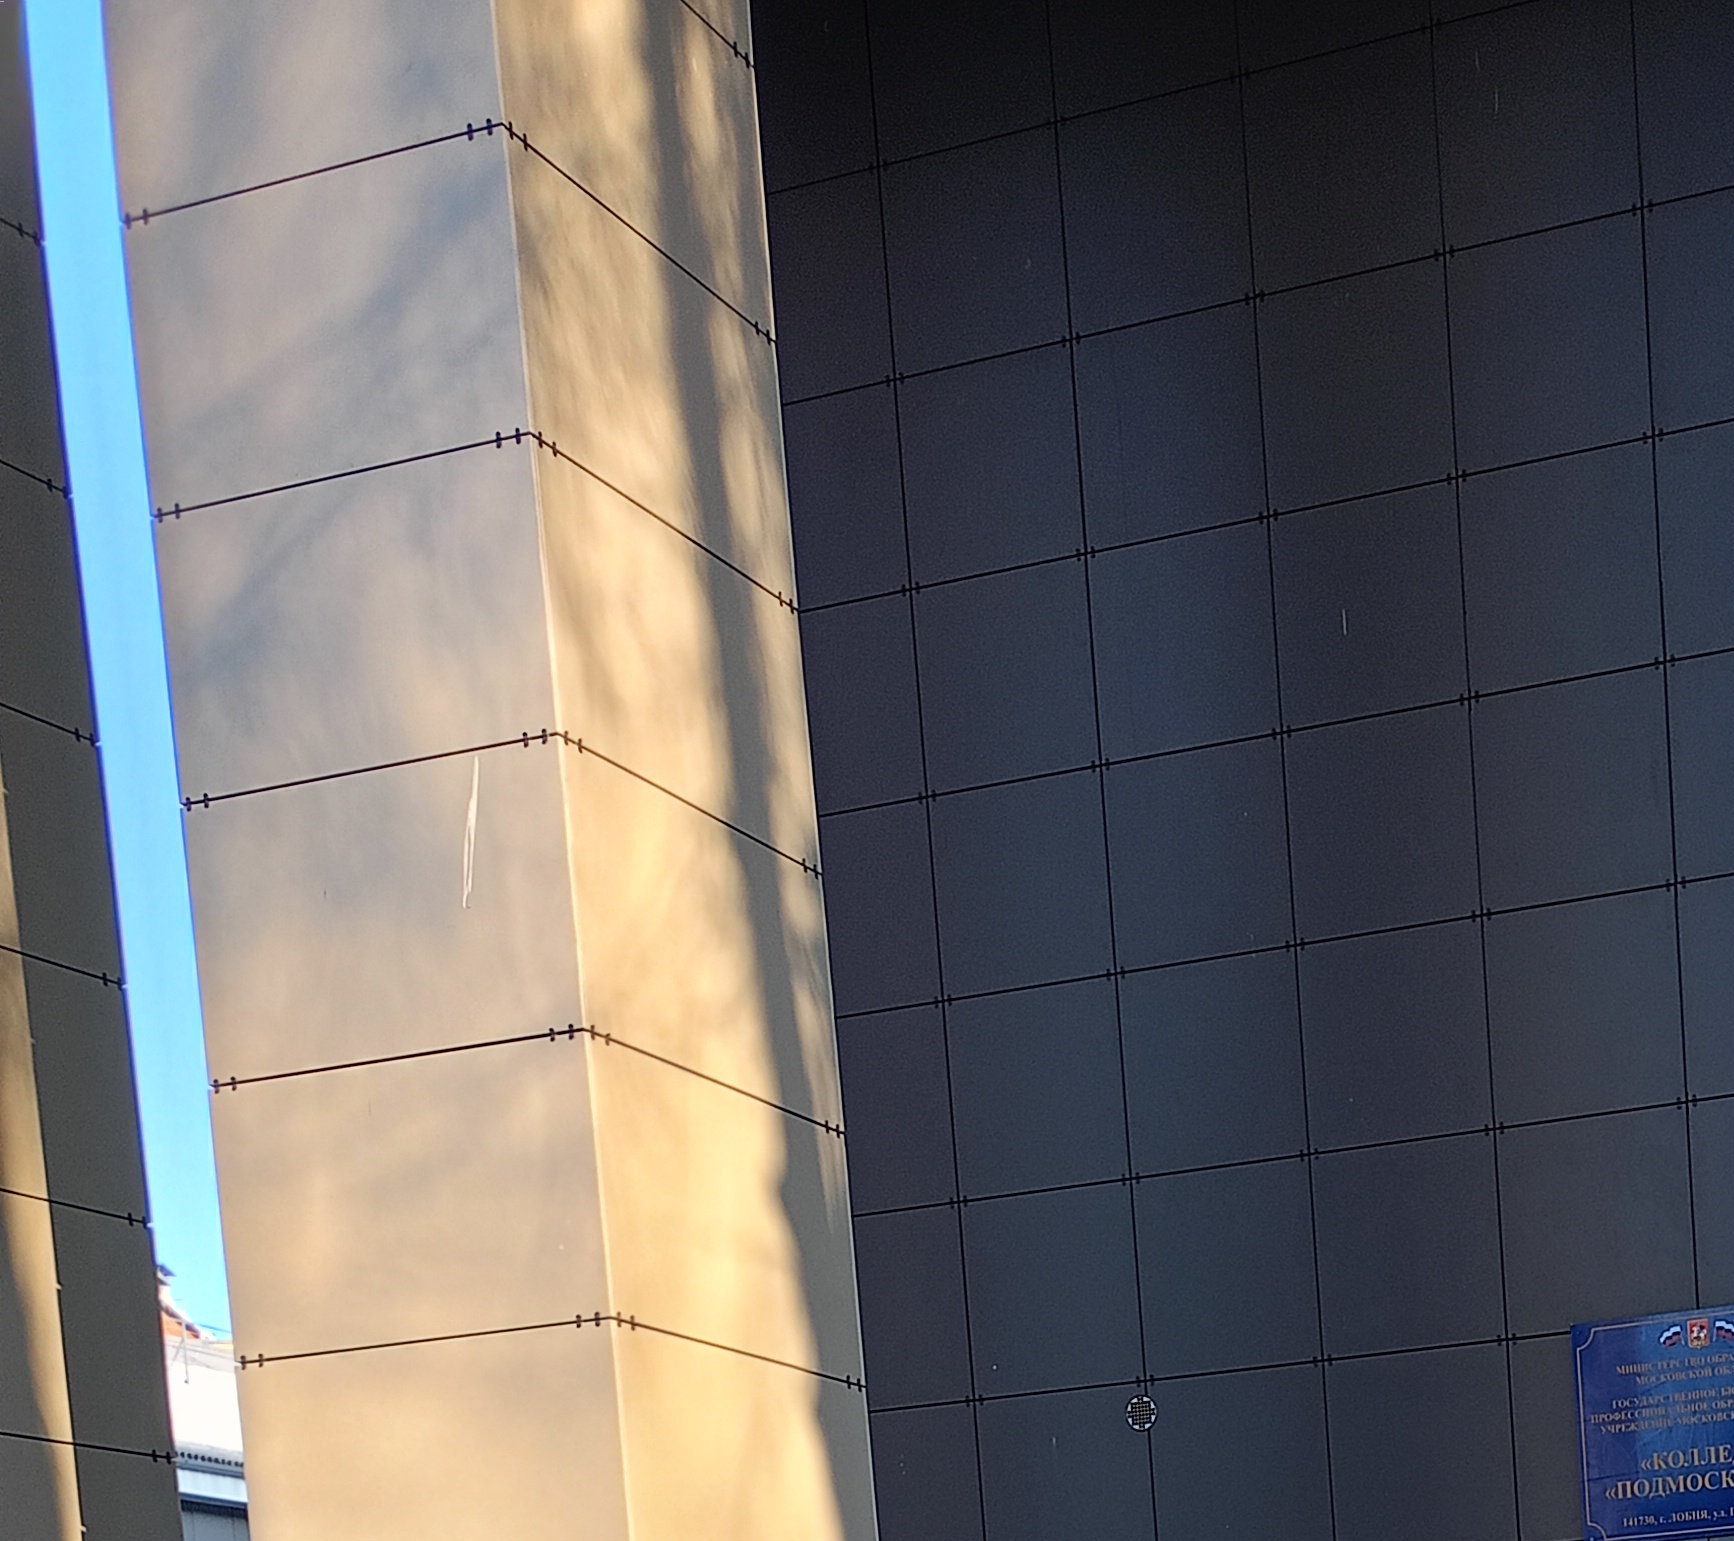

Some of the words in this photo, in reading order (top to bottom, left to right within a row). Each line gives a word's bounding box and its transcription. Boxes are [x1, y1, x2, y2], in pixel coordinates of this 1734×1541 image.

[1616, 1355, 1704, 1375] МИНИСТЕРСТВО
[1636, 1368, 1713, 1385] МОСКОВСКОЙ
[1612, 1389, 1716, 1409] ГОСУДАРСТВЕННОЕ
[1591, 1399, 1708, 1424] ПРОФЕССИОНАЛЬНОЕ
[1600, 1417, 1673, 1435] УЧРЕЖДЕНИЕ
[1668, 1509, 1711, 1522] ЛОБНЯ,
